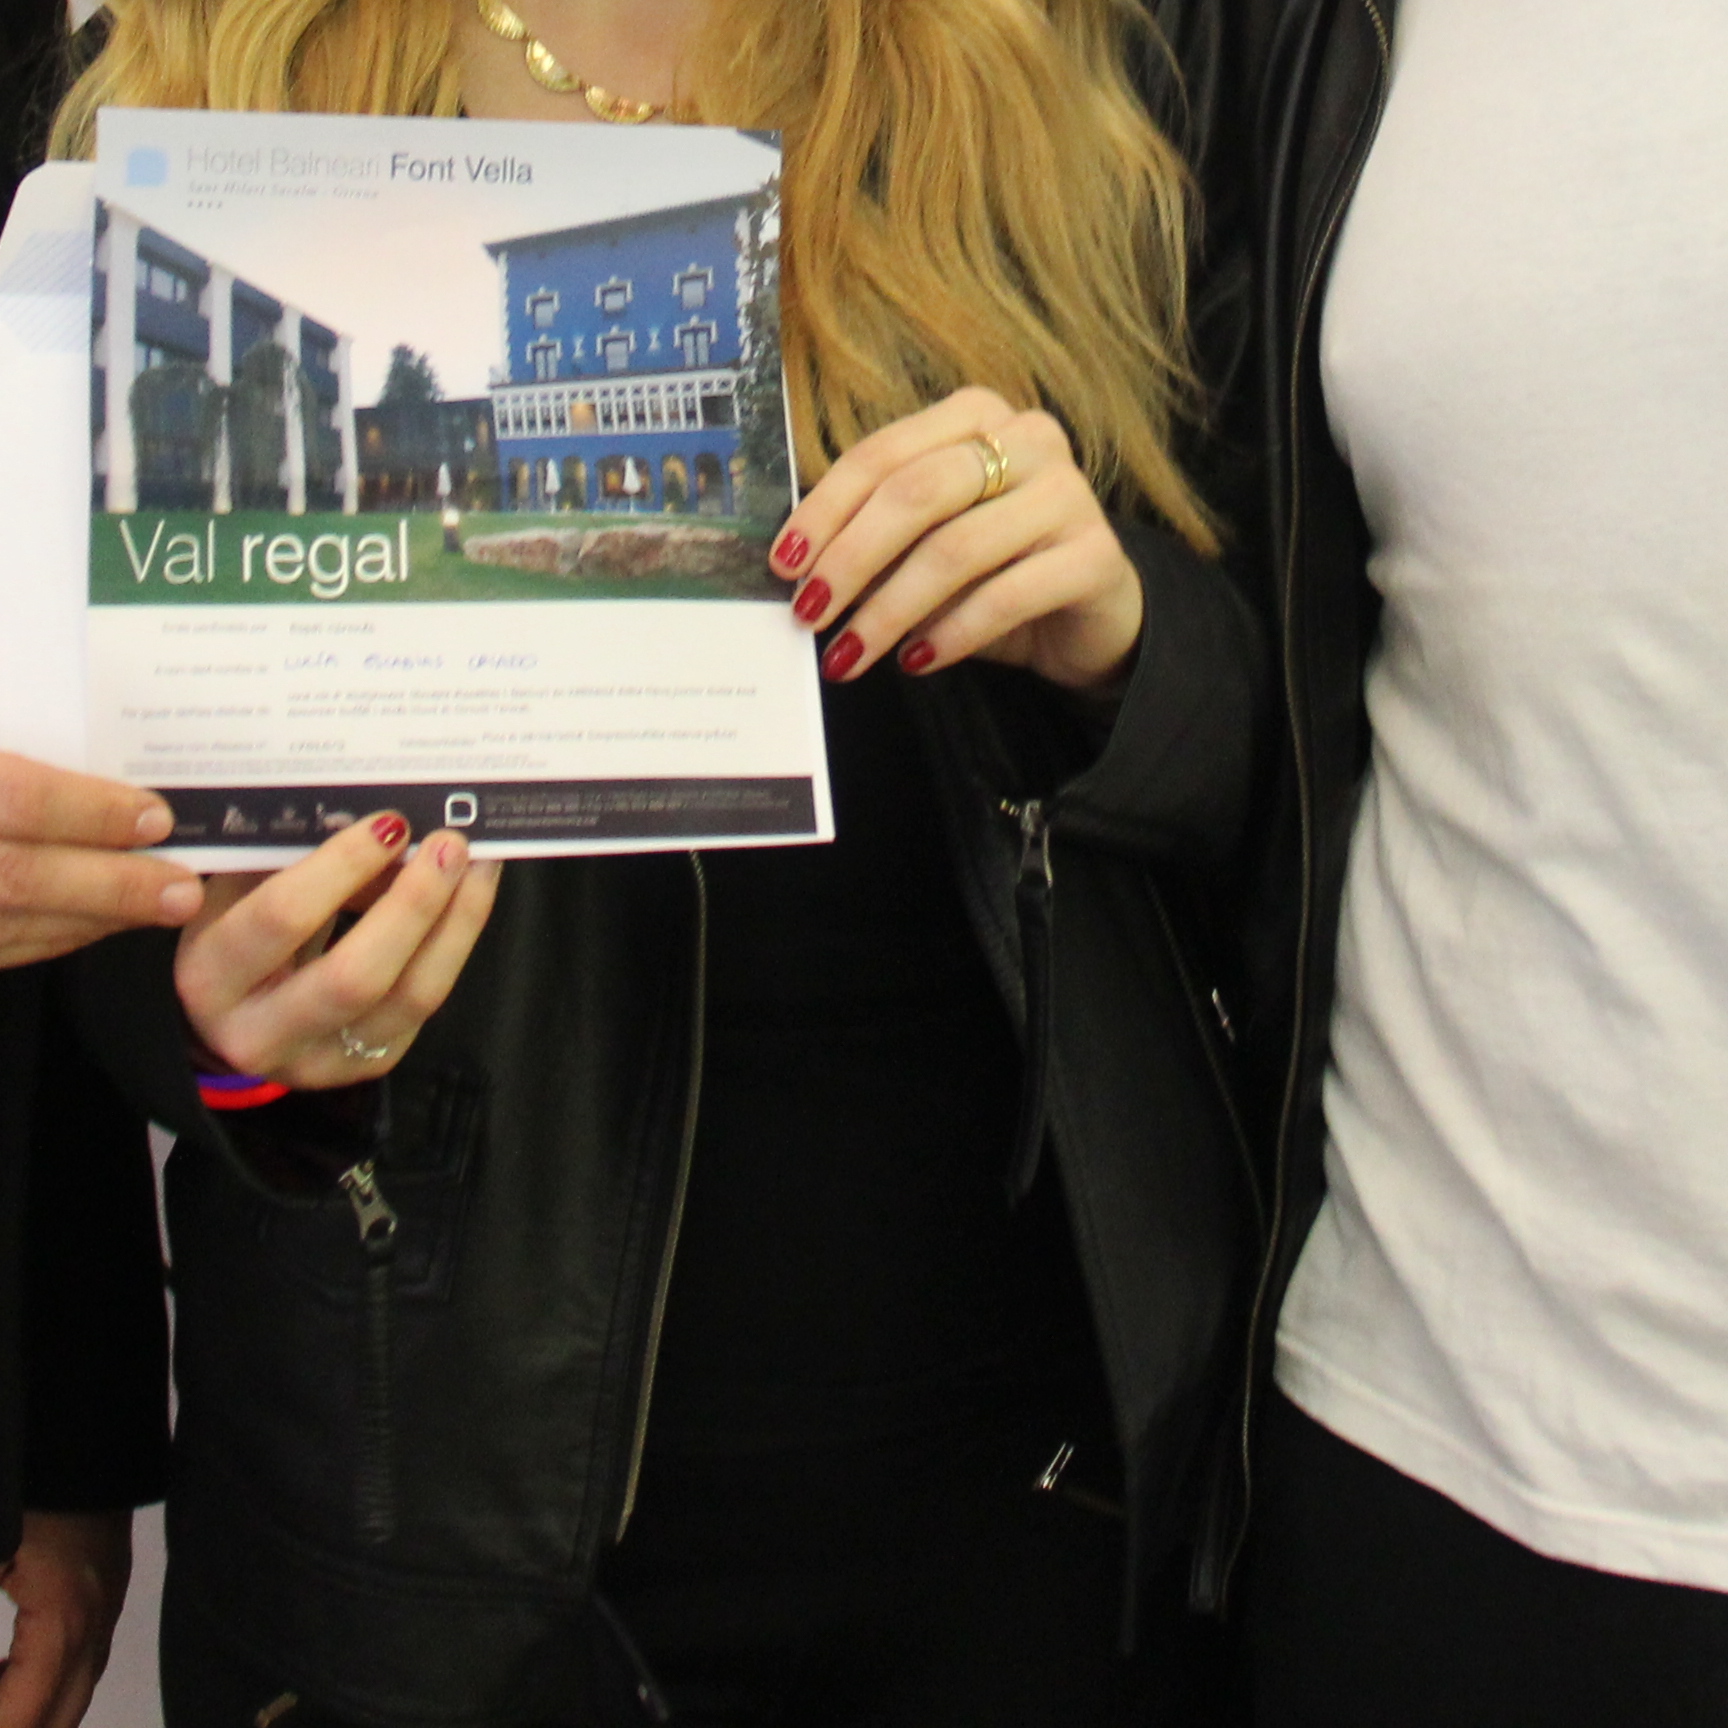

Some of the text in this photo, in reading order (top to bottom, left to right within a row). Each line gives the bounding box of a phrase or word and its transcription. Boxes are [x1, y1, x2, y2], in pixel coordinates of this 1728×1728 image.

[186, 146, 260, 176] Hotel
[390, 152, 455, 183] Font
[463, 155, 534, 185] Vella
[119, 518, 410, 600] Val regal
